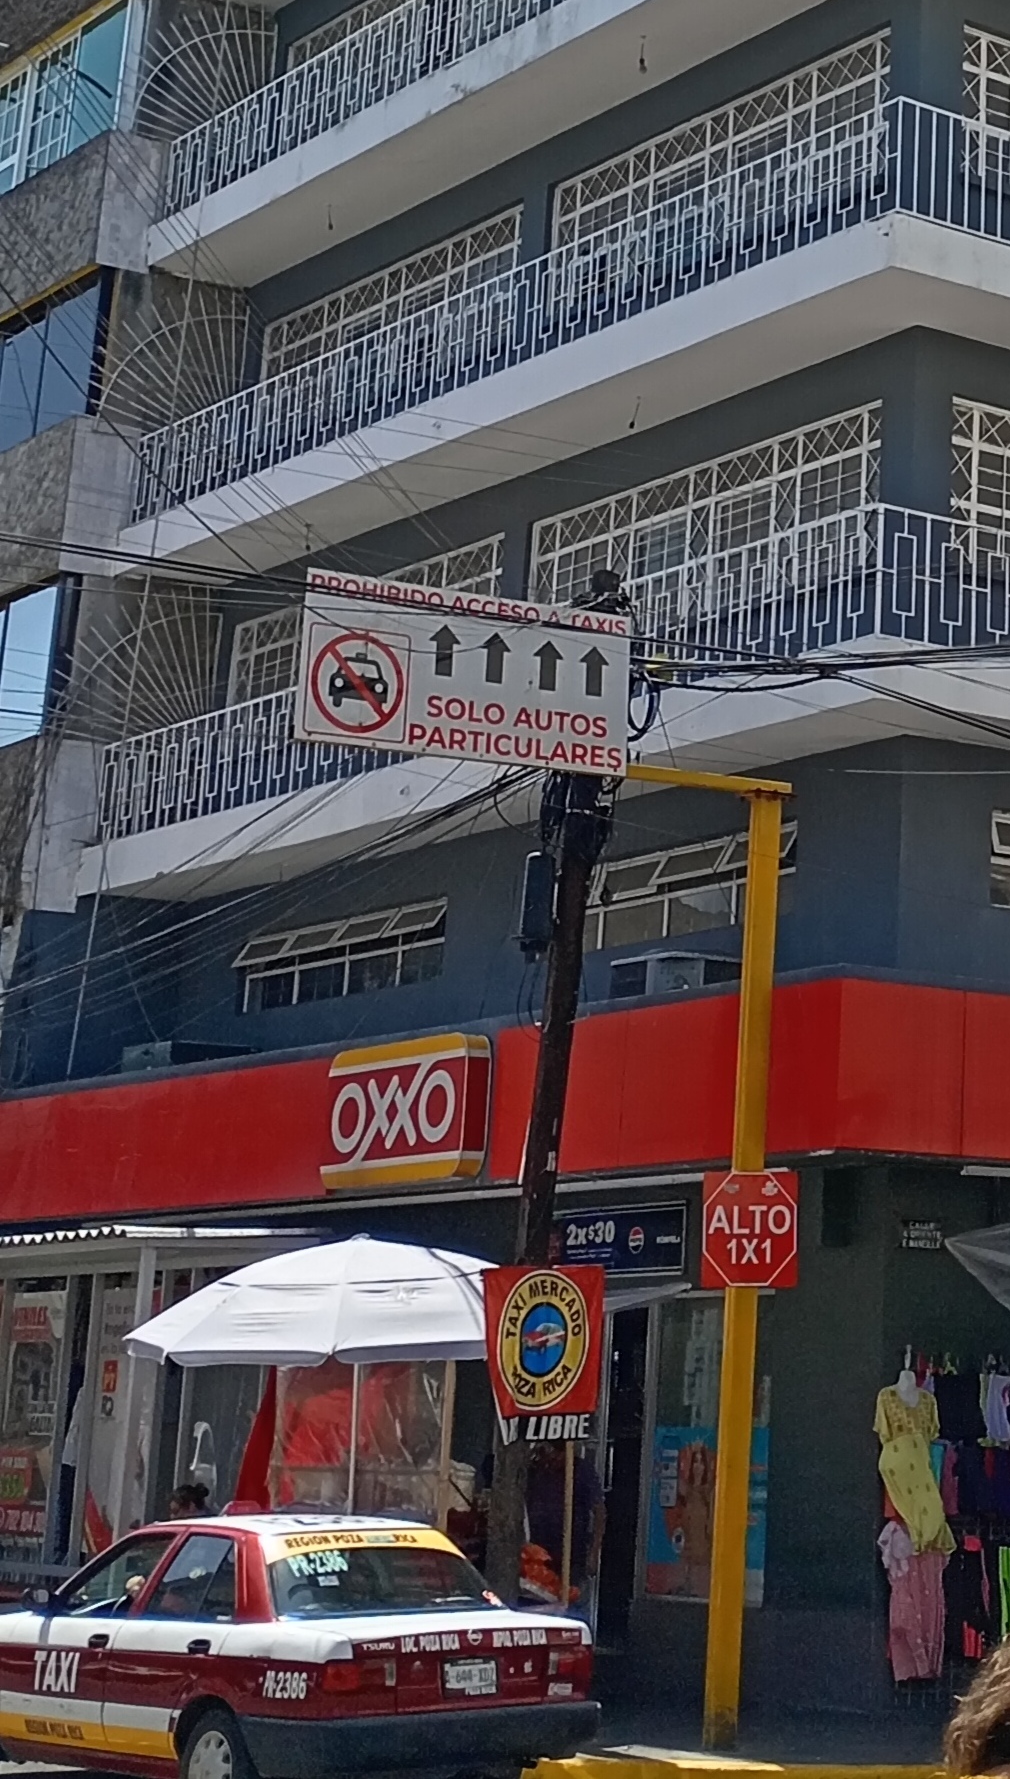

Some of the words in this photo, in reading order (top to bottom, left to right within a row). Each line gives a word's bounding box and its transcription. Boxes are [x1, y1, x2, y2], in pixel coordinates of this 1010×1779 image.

[427, 694, 505, 723] SOLO
[513, 706, 608, 739] AUTOS
[408, 723, 623, 769] PARTICULARES
[331, 1068, 456, 1160] OXXO
[708, 1205, 791, 1235] ALTO
[726, 1238, 772, 1265] 1X1
[505, 1295, 528, 1339] TAXI
[529, 1279, 582, 1338] MERCADO
[543, 1364, 573, 1396] RICA
[526, 1414, 591, 1440] LIBRE
[34, 1650, 81, 1693] TAXI
